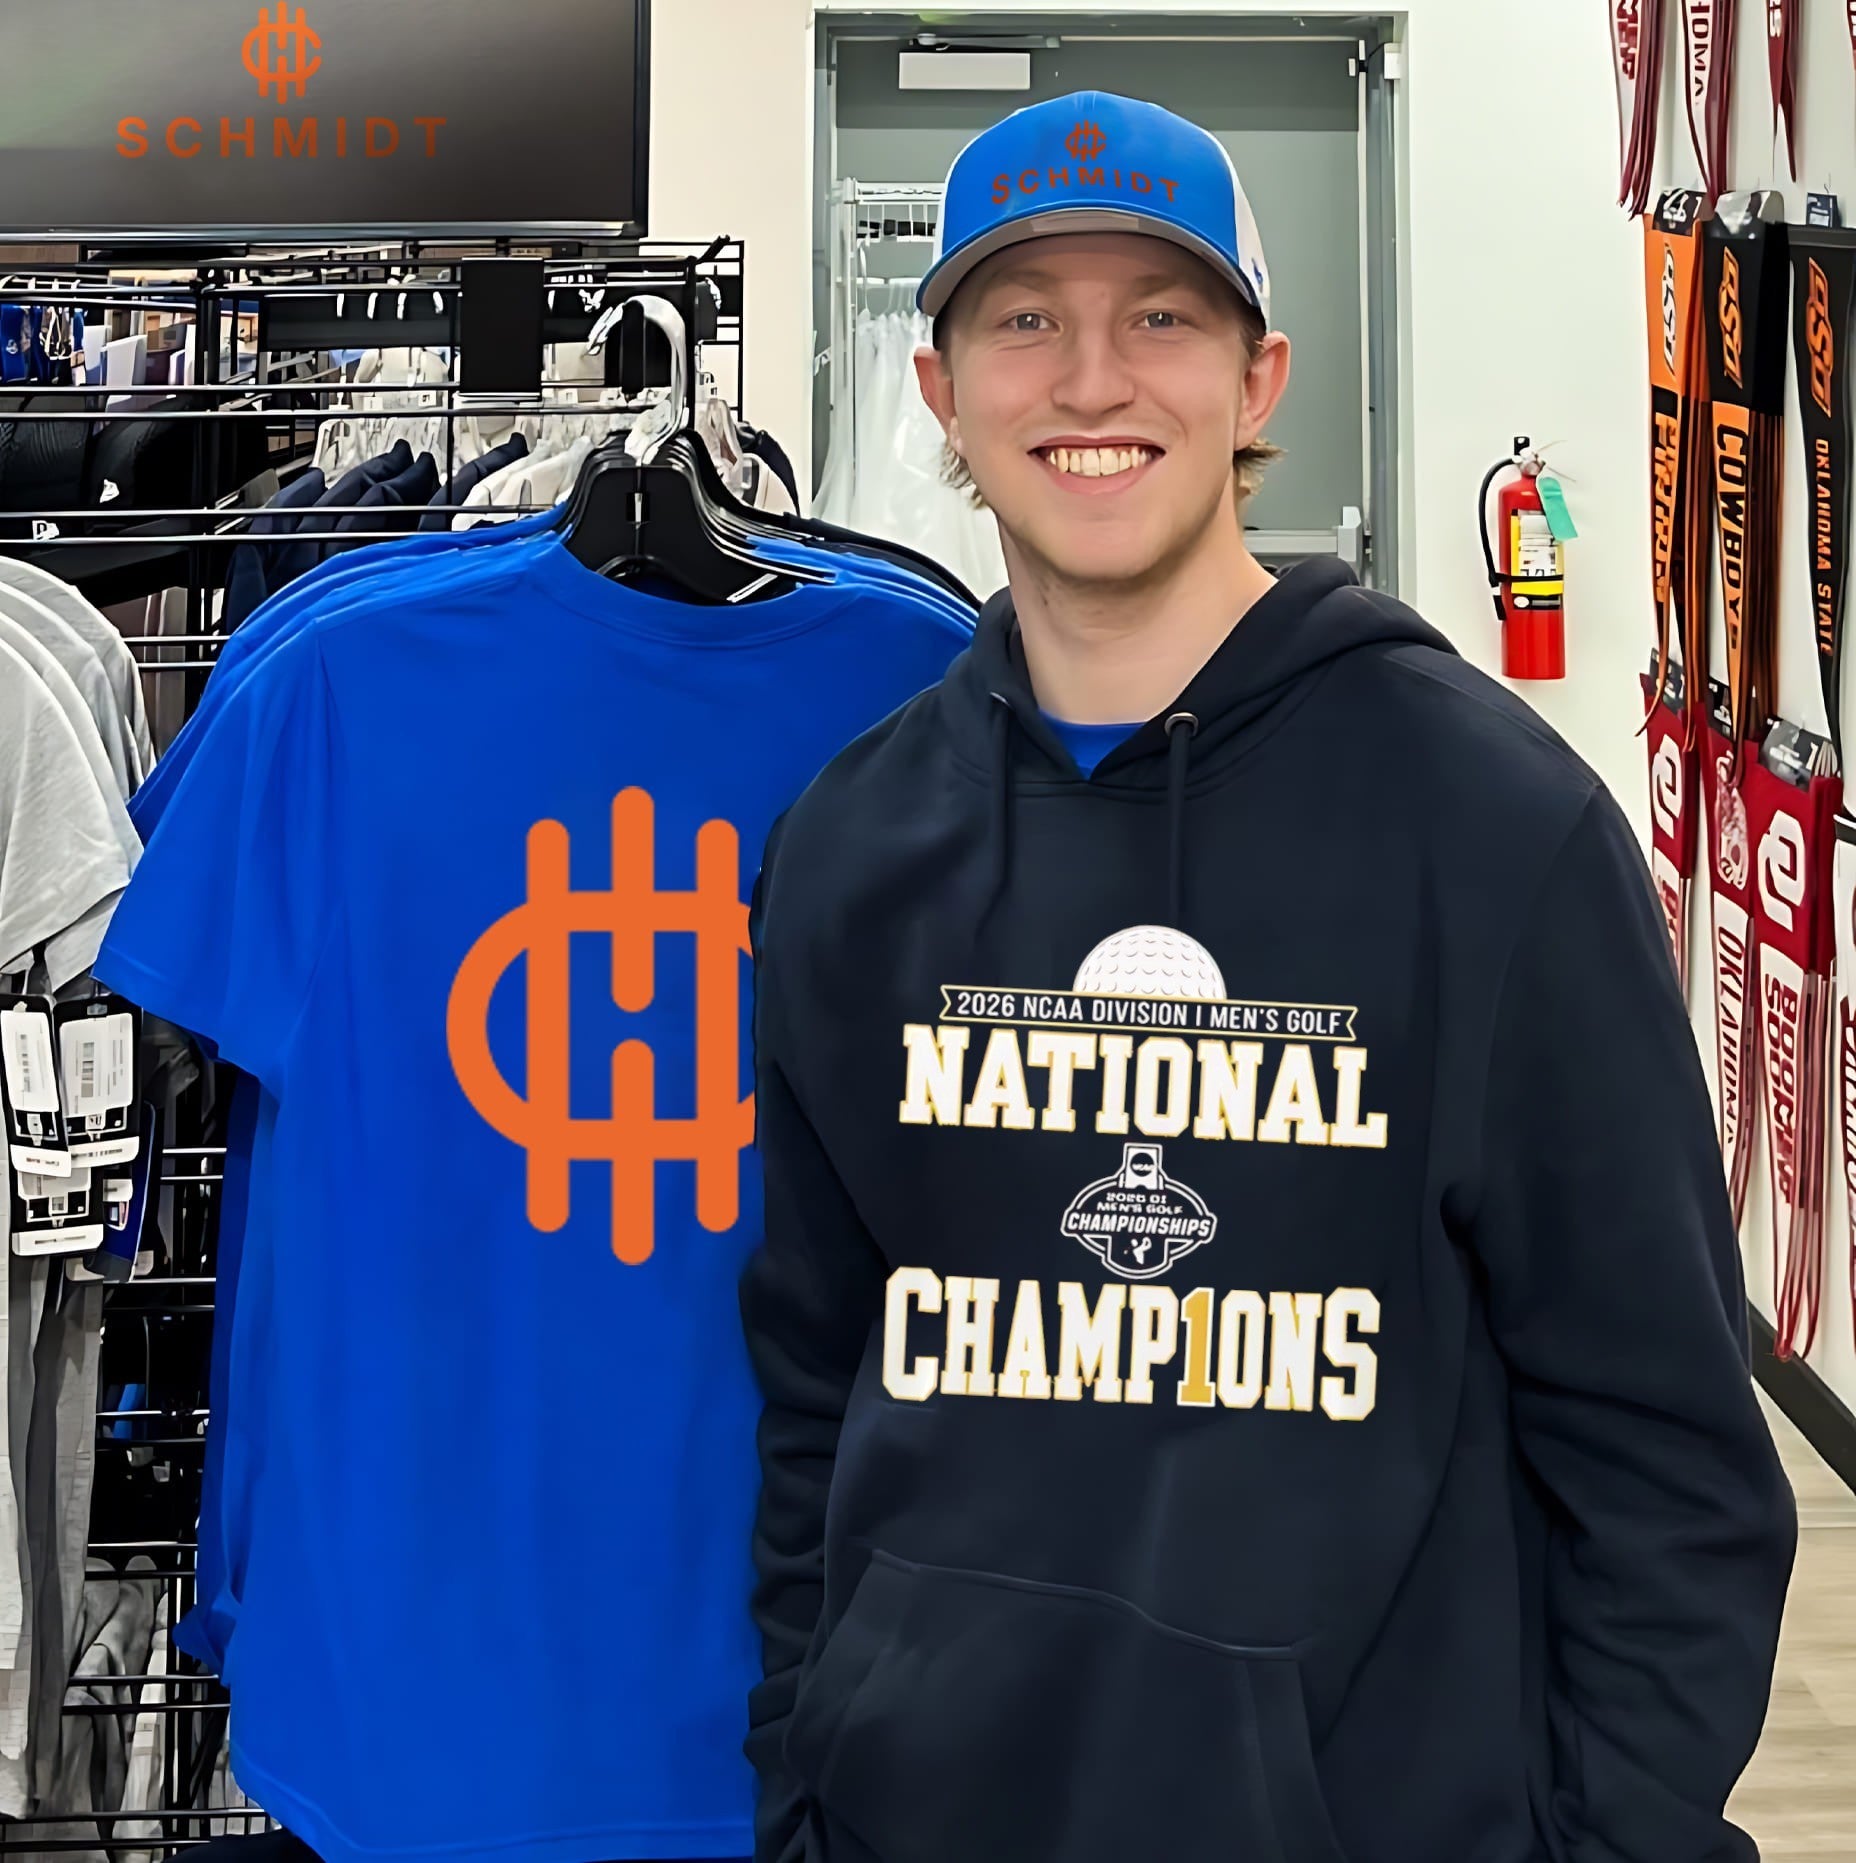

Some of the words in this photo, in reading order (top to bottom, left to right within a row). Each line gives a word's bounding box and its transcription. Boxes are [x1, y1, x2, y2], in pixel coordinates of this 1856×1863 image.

[116, 117, 447, 158] SCHMIDT
[991, 167, 1179, 205] SCHMIDT
[956, 992, 1015, 1017] 2026
[1023, 996, 1083, 1021] NCAA
[1092, 1000, 1187, 1027] DIVISION
[1210, 1006, 1279, 1031] MEN'S
[1286, 1009, 1342, 1035] GOLF
[899, 1023, 1388, 1148] NATIONAL
[1067, 1212, 1211, 1237] CHAMPIONSHIPS
[882, 1266, 1381, 1421] CHAMP1ONS
